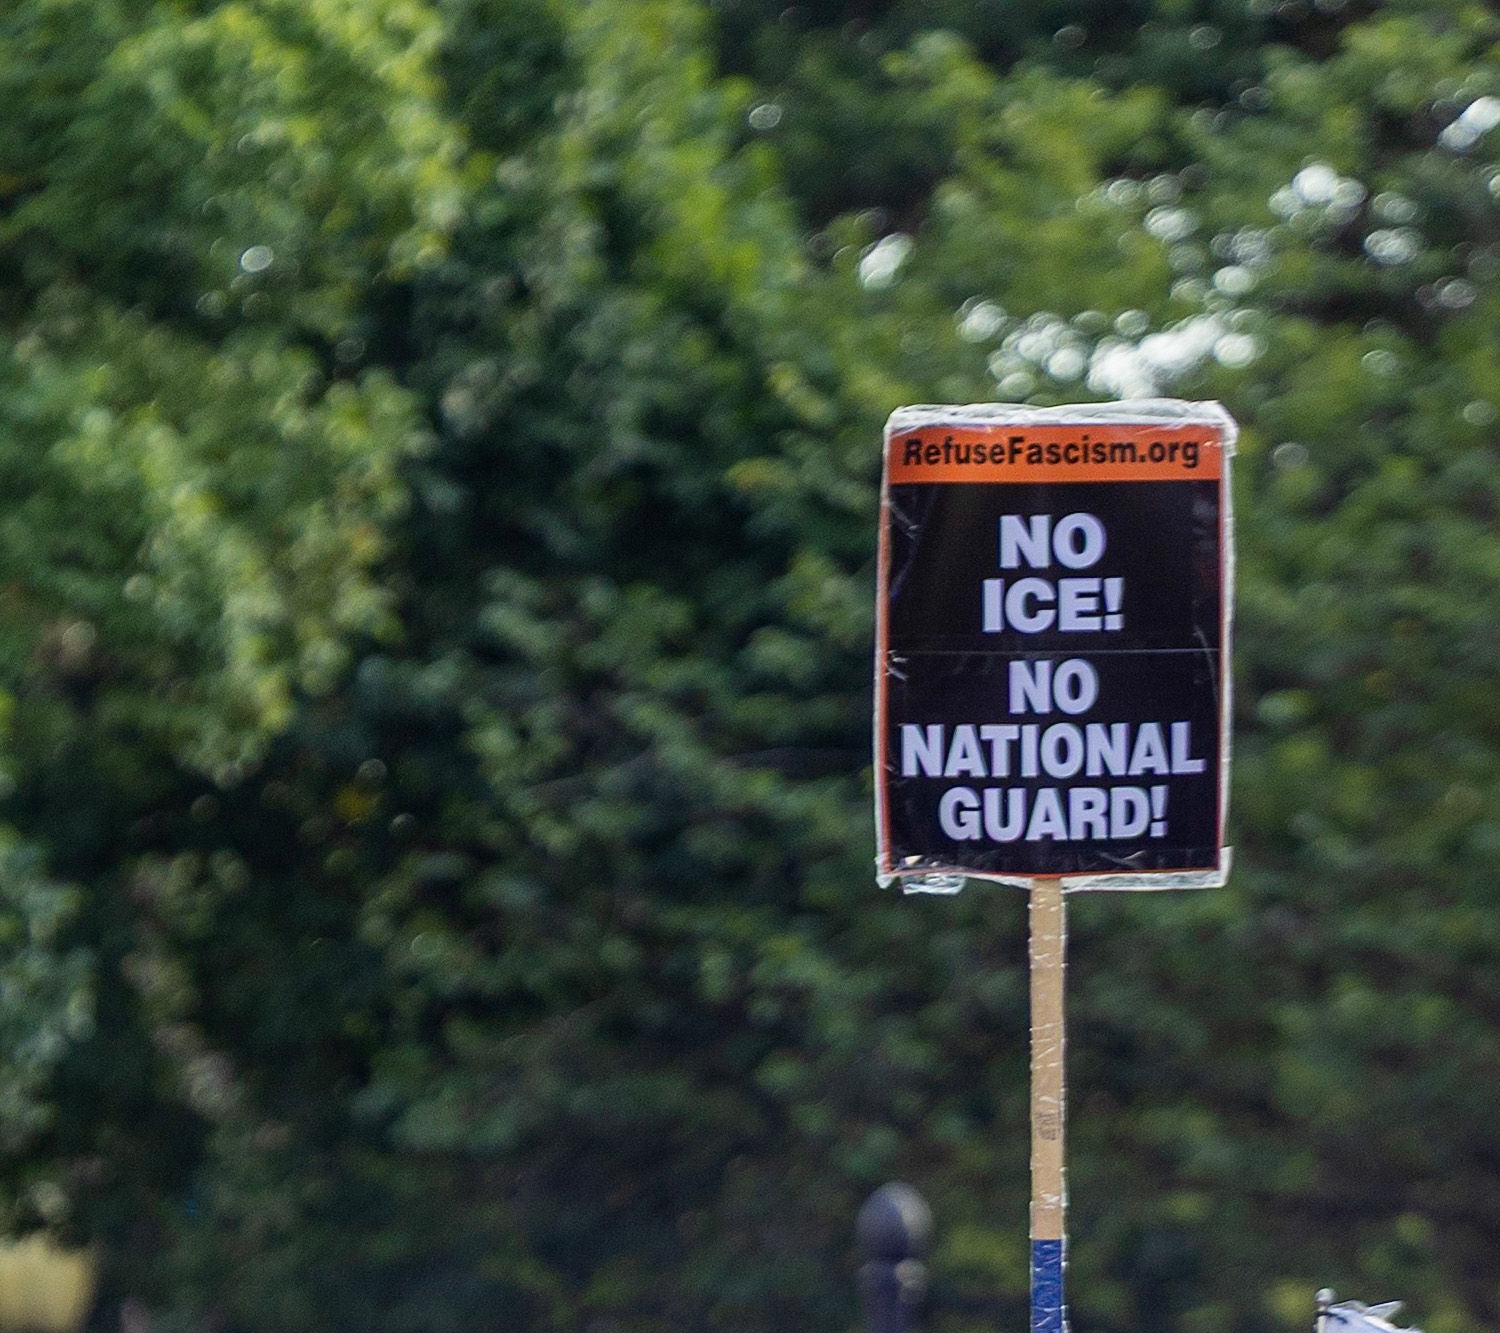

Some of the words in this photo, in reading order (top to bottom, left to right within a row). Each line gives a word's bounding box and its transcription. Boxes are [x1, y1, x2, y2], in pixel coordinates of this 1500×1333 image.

[903, 436, 1200, 470] RefuseFascism.org
[999, 512, 1107, 570] NO
[981, 577, 1125, 634] ICE!
[1008, 658, 1099, 715] NO
[902, 722, 1206, 780] NATIONAL
[939, 785, 1168, 843] GUARD!
